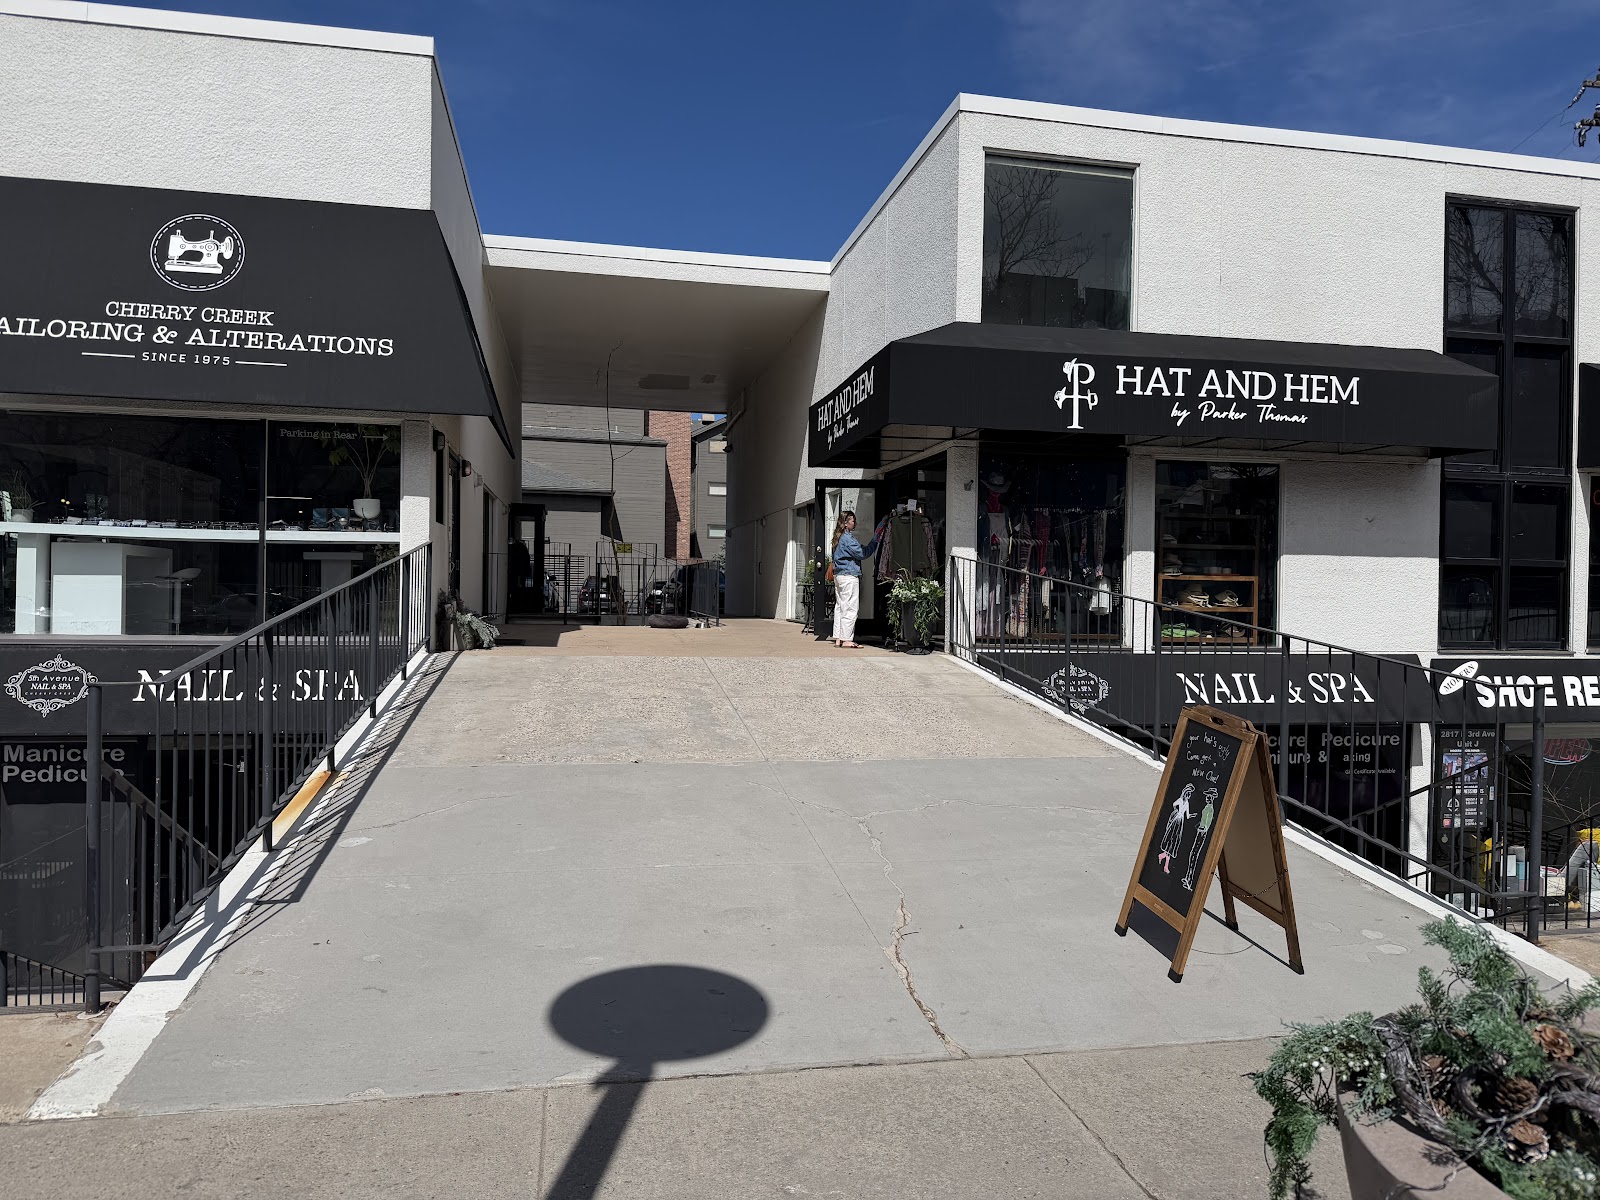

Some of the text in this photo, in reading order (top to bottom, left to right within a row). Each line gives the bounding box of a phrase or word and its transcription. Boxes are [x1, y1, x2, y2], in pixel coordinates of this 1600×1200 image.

[105, 301, 274, 326] CHERRY CREEK
[0, 316, 394, 356] AILORING & ALTERATIONS
[141, 351, 230, 366] SINCE 1975
[1115, 365, 1360, 405] HAT AND HEM
[817, 365, 875, 432] HAT AND HEM
[1170, 400, 1308, 427] by Parker Thomas
[280, 428, 357, 440] Parking in Rear
[27, 674, 40, 682] 5th
[1175, 672, 1375, 704] NAIL & SPA
[1474, 675, 1600, 708] SHOE RE
[1321, 733, 1400, 746] Pedicure
[3, 744, 126, 763] Manicre
